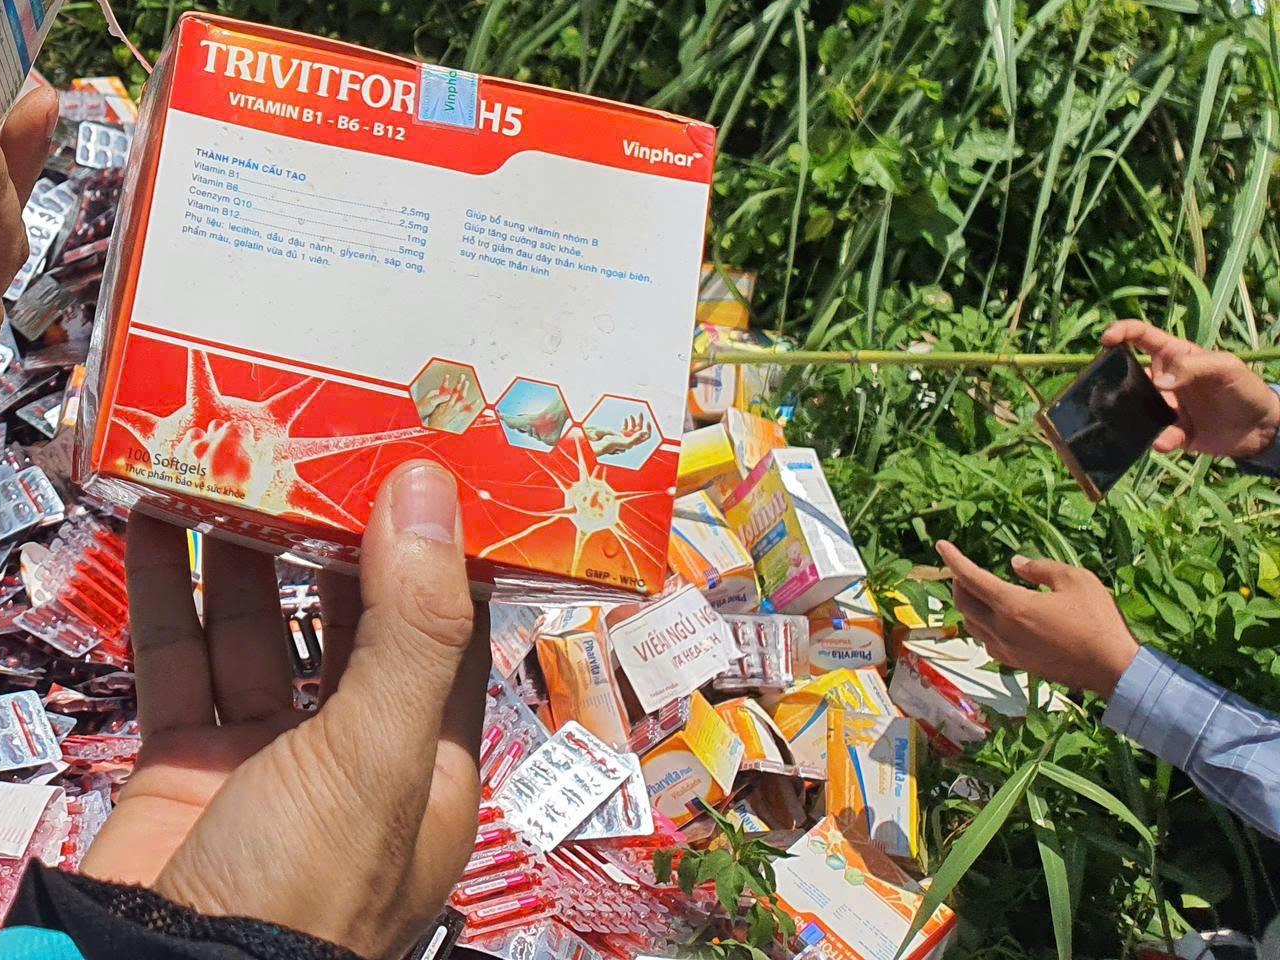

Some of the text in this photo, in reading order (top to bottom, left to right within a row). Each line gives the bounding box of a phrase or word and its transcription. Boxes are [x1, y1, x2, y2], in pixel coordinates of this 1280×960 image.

[228, 91, 407, 141] VITAMIN B1 B6 B12
[479, 100, 524, 137] H5
[622, 138, 695, 168] Vinphar
[191, 173, 223, 189] Vitamin
[194, 159, 240, 179] Vitamin B1
[187, 198, 425, 260] Vitamin B12 5mcg
[189, 185, 427, 247] Coenzym Q10 1mg
[465, 208, 487, 222] Giúp
[503, 219, 525, 233] sung
[527, 225, 560, 240] vitamin
[562, 231, 589, 245] nhóm
[591, 238, 599, 247] B
[233, 238, 264, 251] gelatin
[464, 222, 485, 235] Giúp
[488, 228, 507, 241] tăng
[460, 249, 476, 260] suy
[530, 266, 550, 278] kinh
[516, 249, 533, 260] đau
[535, 253, 552, 266] dây
[578, 263, 597, 273] kinh
[126, 447, 207, 477] 100 Softgels
[124, 463, 146, 480] Thực
[147, 470, 174, 484] phẩm
[175, 475, 193, 487] bảo
[193, 480, 206, 491] vệ
[585, 568, 647, 589] GMP WHO
[583, 639, 601, 676] Pharvita
[831, 649, 872, 662] Pharvita
[646, 769, 682, 797] Pharvita
[735, 803, 760, 833] Pharv
